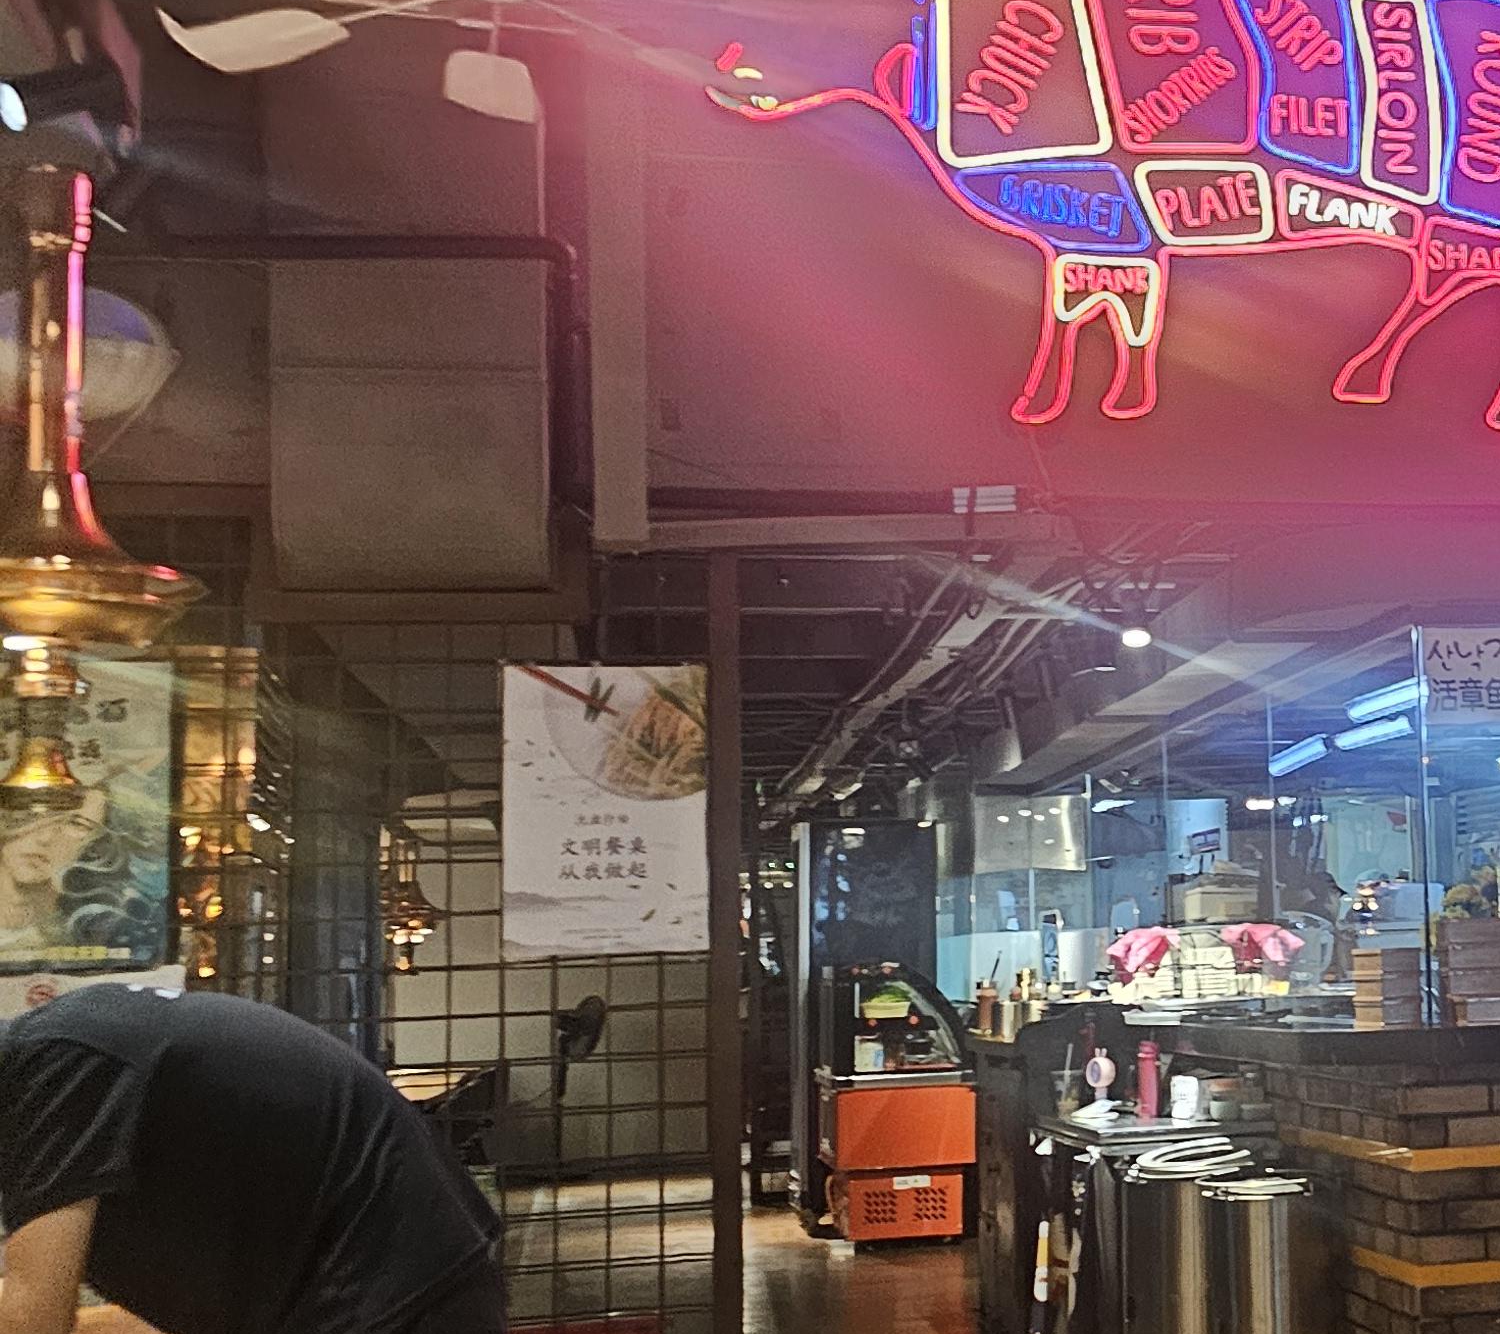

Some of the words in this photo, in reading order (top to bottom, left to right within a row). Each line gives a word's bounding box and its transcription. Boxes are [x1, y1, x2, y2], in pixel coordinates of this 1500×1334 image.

[1270, 94, 1349, 137] FILET
[1373, 3, 1419, 174] SIRLOIN
[1154, 172, 1261, 230] PLATE
[1288, 182, 1400, 236] FLANK
[1063, 263, 1150, 294] SHANK
